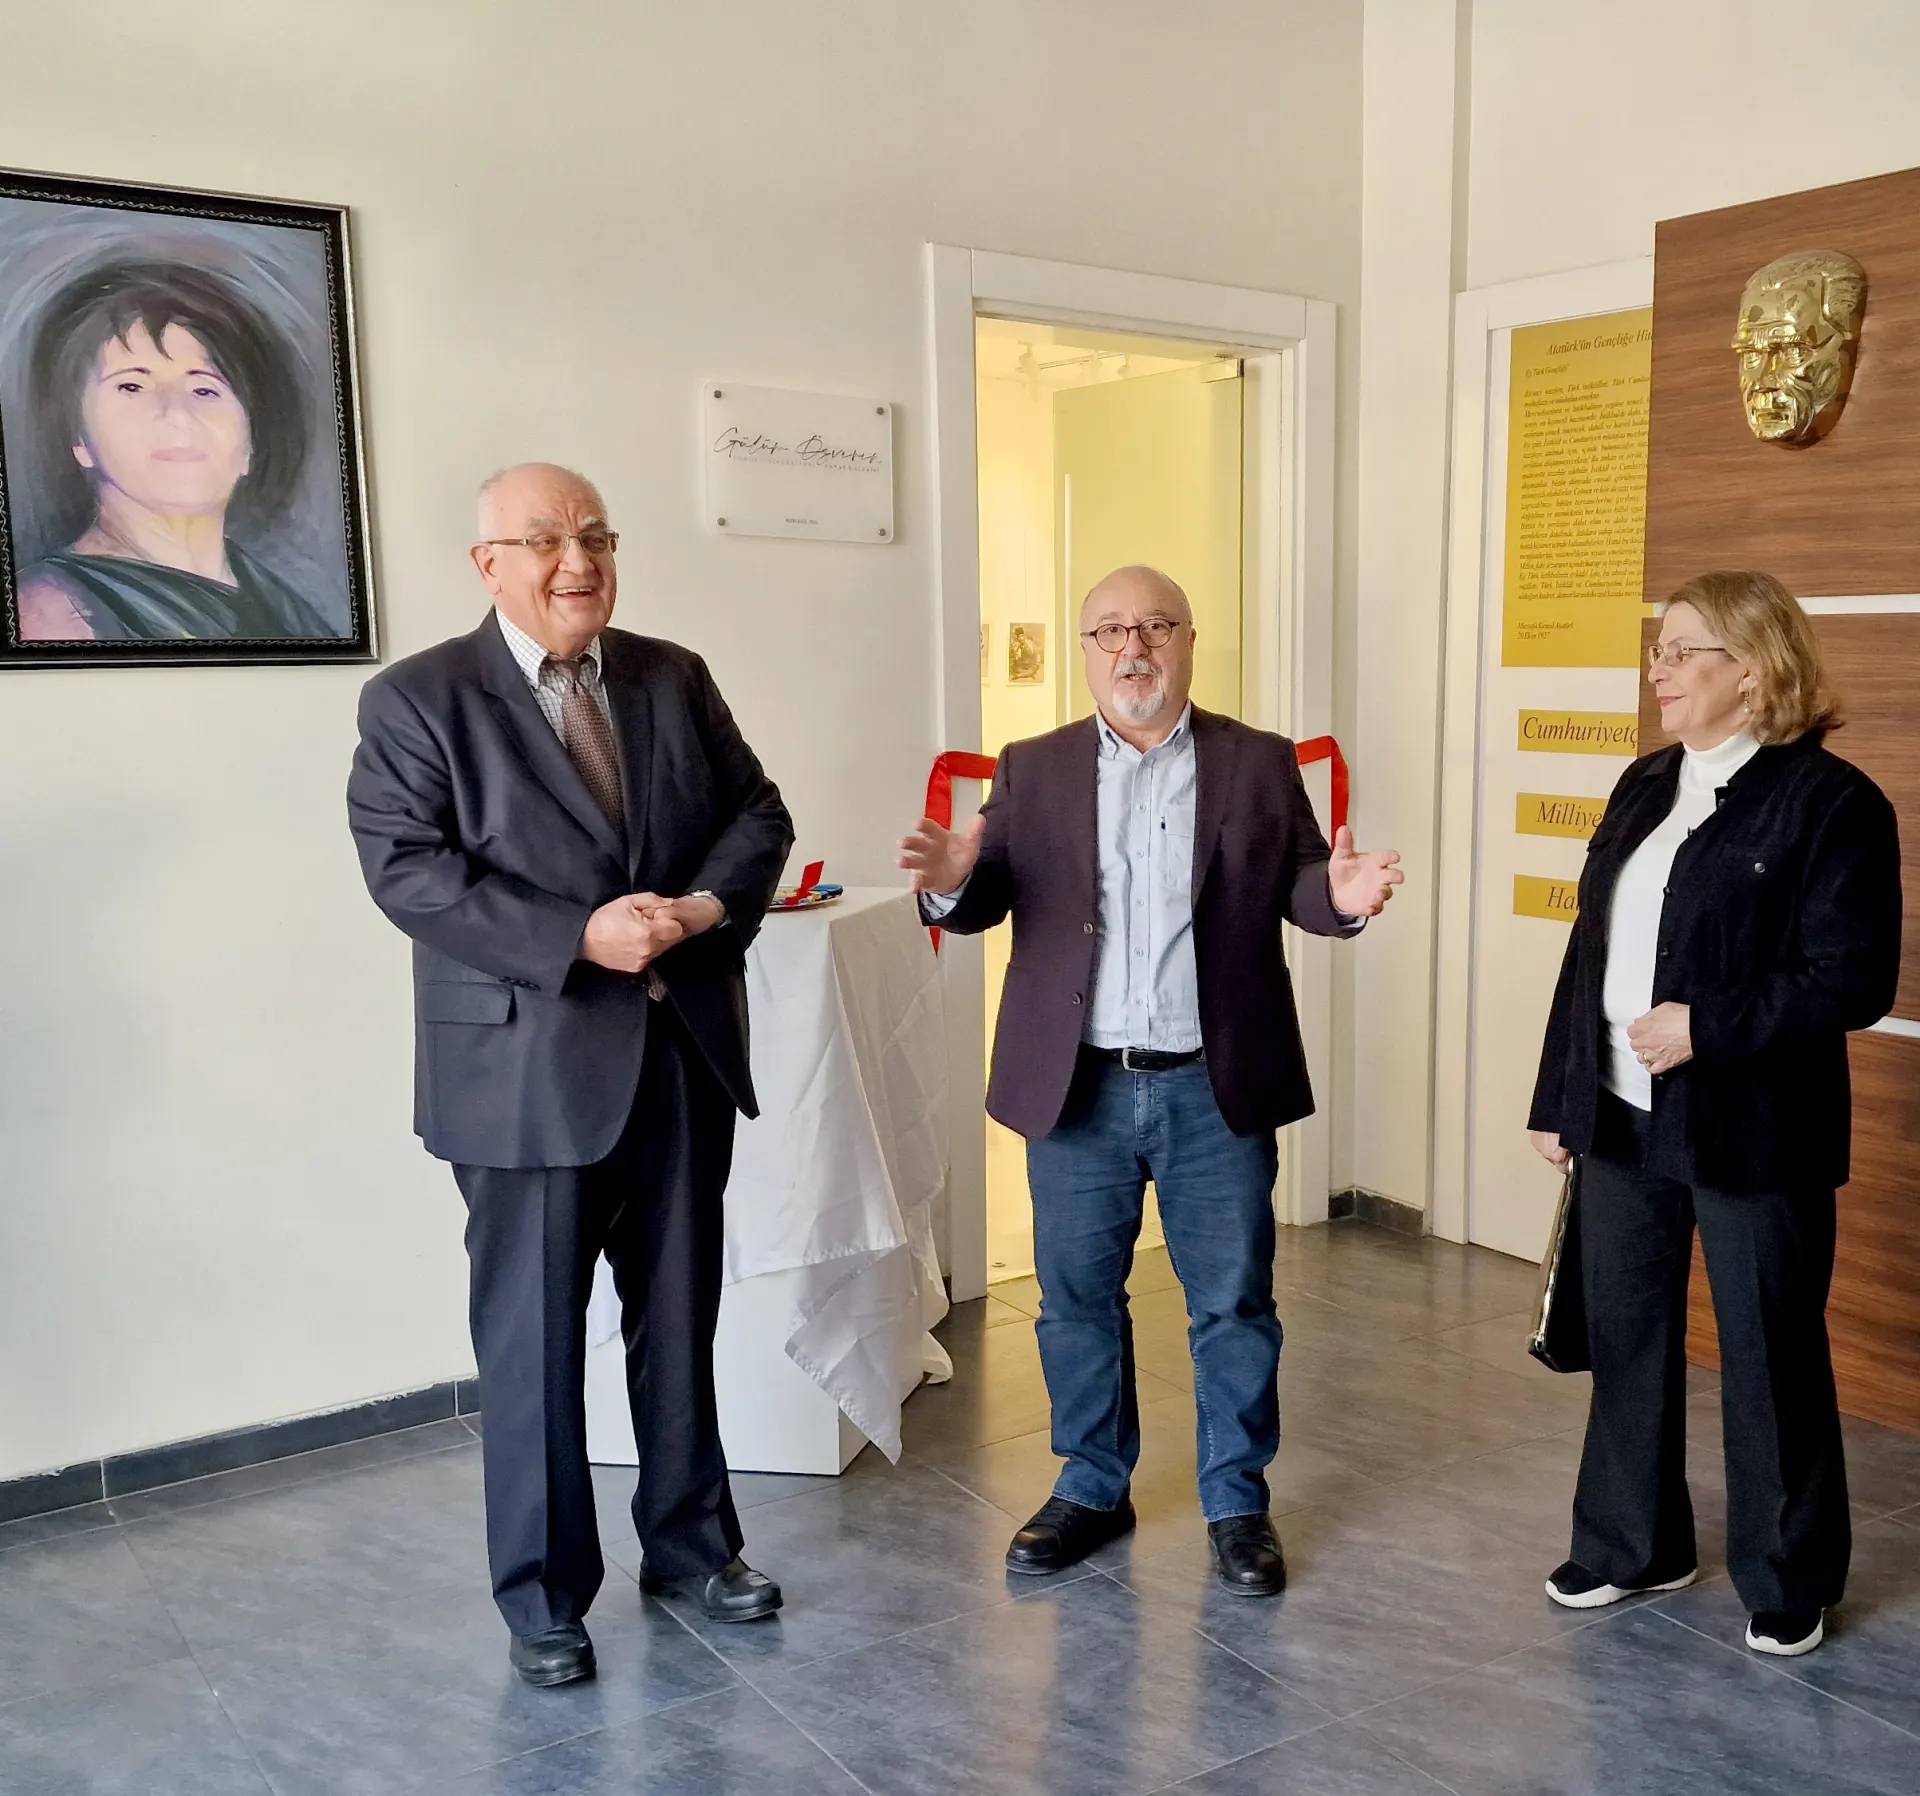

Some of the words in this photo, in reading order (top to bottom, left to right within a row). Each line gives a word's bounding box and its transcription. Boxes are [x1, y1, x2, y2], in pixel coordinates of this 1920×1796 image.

[1545, 340, 1591, 356] Atatürk'ün
[1593, 332, 1634, 349] Gençliğe
[1536, 801, 1603, 833] Milliye
